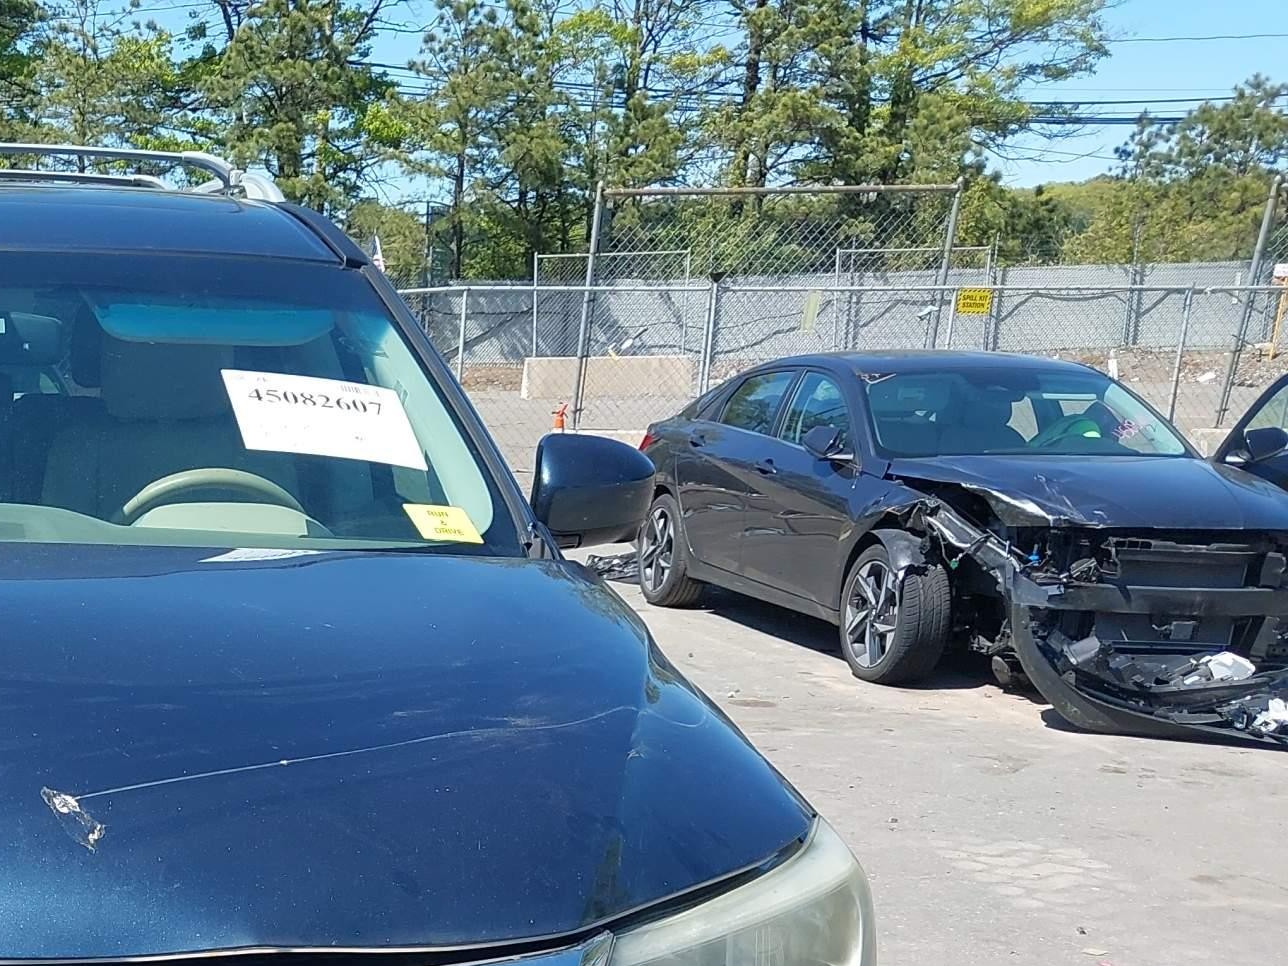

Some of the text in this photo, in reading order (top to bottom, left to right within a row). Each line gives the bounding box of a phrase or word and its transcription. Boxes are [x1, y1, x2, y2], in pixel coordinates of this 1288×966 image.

[248, 388, 382, 416] 45082607
[426, 510, 449, 518] RUN
[434, 527, 465, 536] DRIVE
